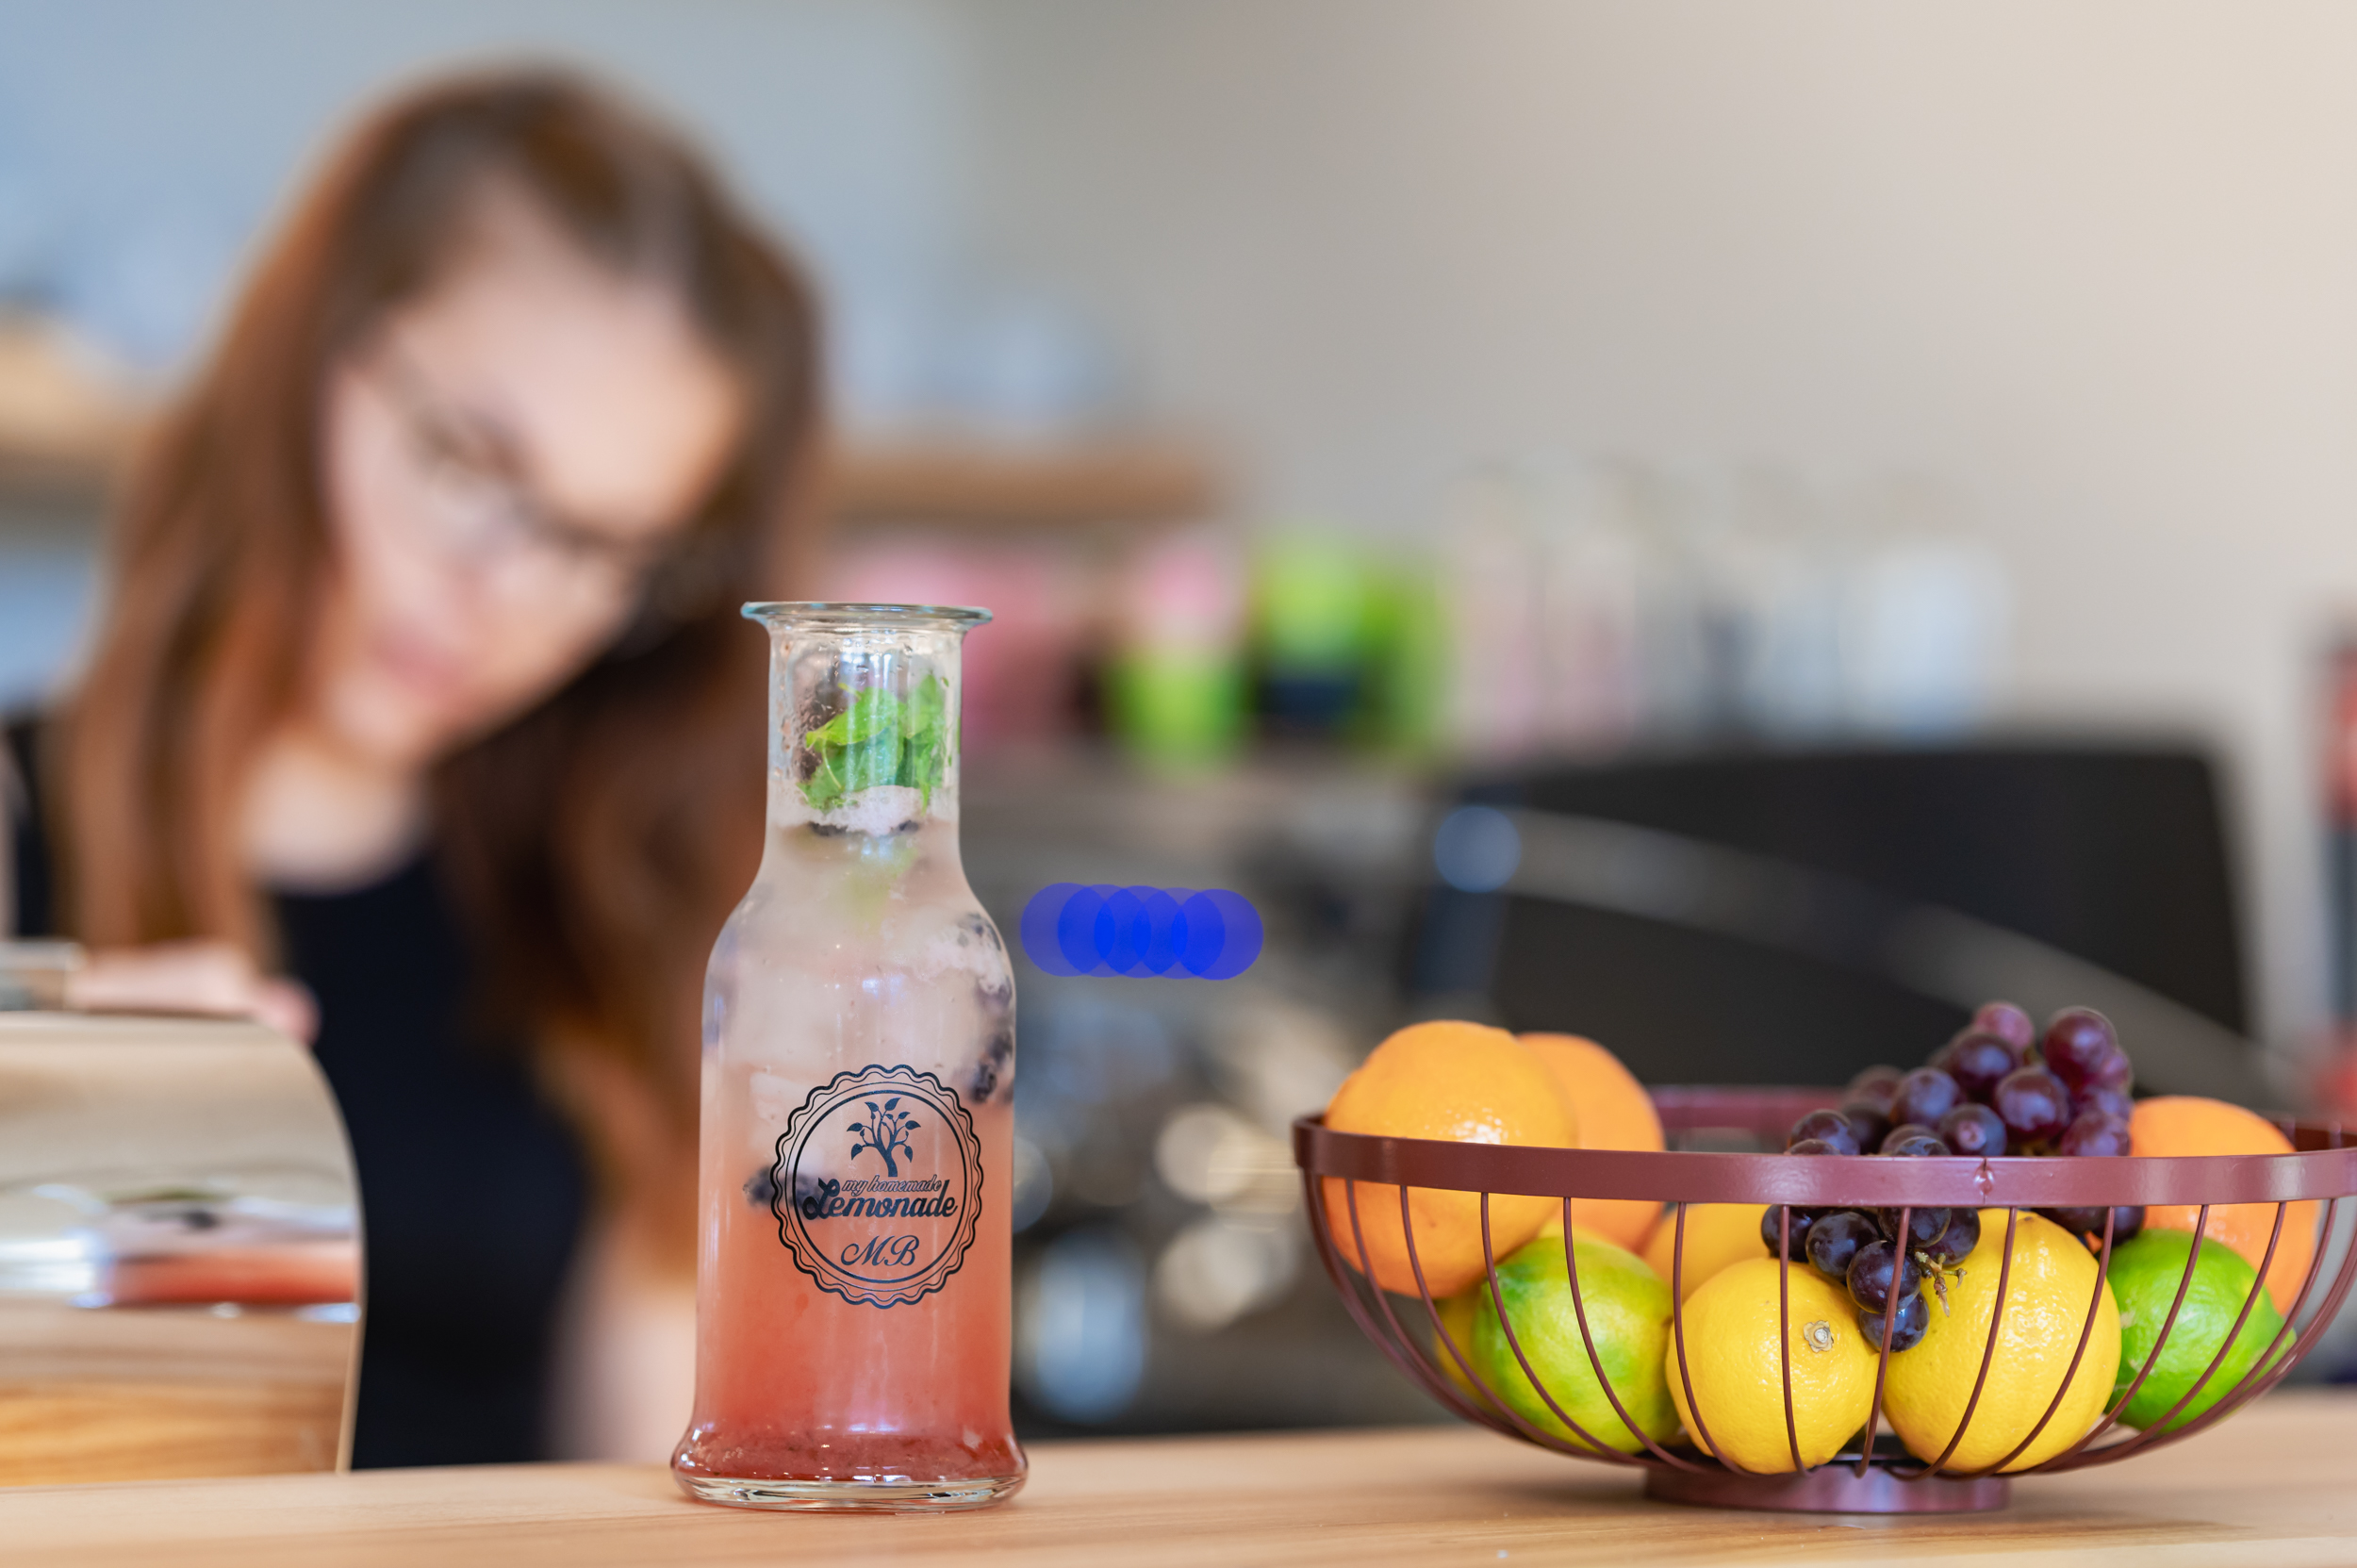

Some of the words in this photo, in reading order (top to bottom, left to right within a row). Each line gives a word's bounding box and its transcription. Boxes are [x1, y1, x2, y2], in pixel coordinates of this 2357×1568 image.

[802, 1177, 958, 1220] Lemonade
[842, 1180, 866, 1197] my
[867, 1174, 942, 1192] homemade
[840, 1234, 920, 1266] MB
